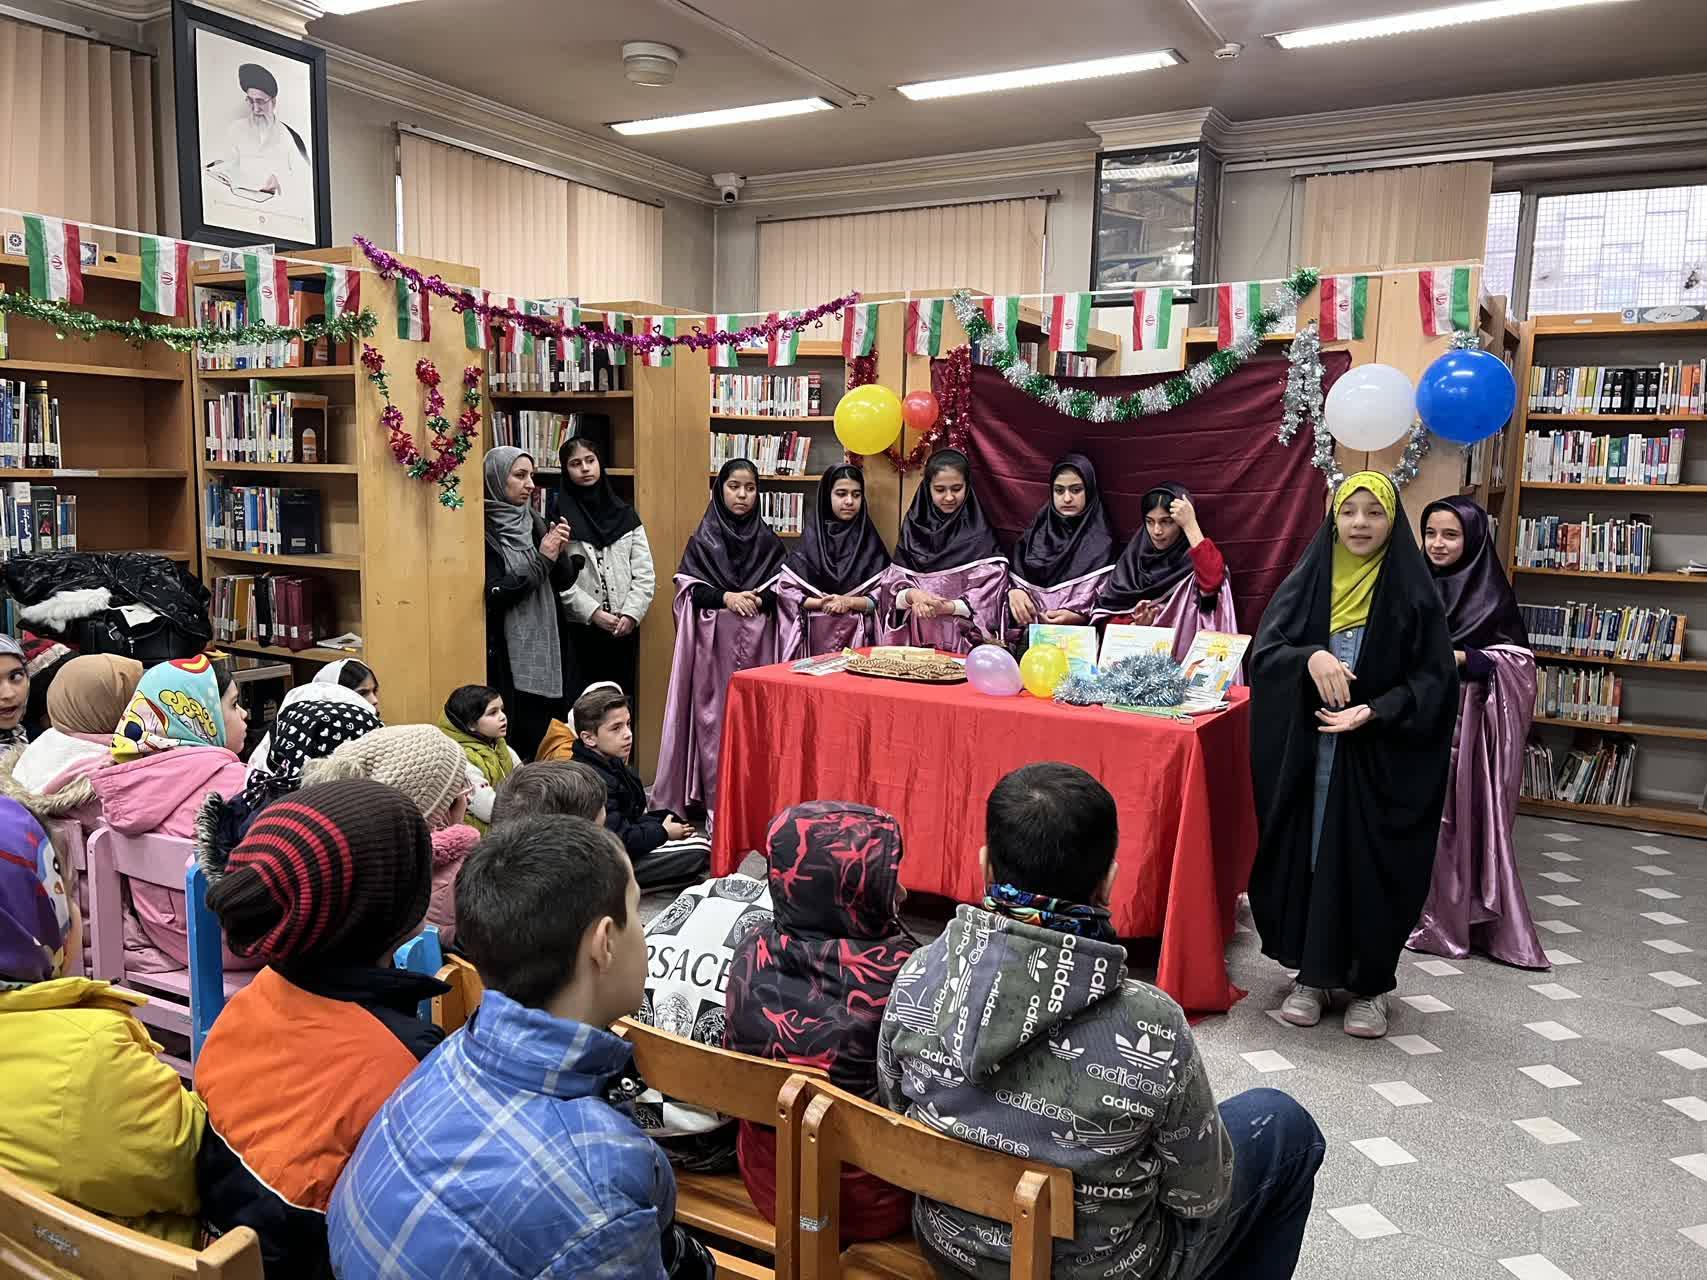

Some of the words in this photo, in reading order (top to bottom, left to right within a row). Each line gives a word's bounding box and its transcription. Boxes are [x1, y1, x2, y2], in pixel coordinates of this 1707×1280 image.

[1048, 934, 1076, 1013] adidas
[1086, 1063, 1166, 1099] adidas
[995, 1089, 1073, 1122] adidas
[1102, 1094, 1155, 1118] adidas
[953, 1122, 1030, 1158] adidas
[933, 1232, 977, 1266] adidas
[1103, 1242, 1147, 1277] adidas
